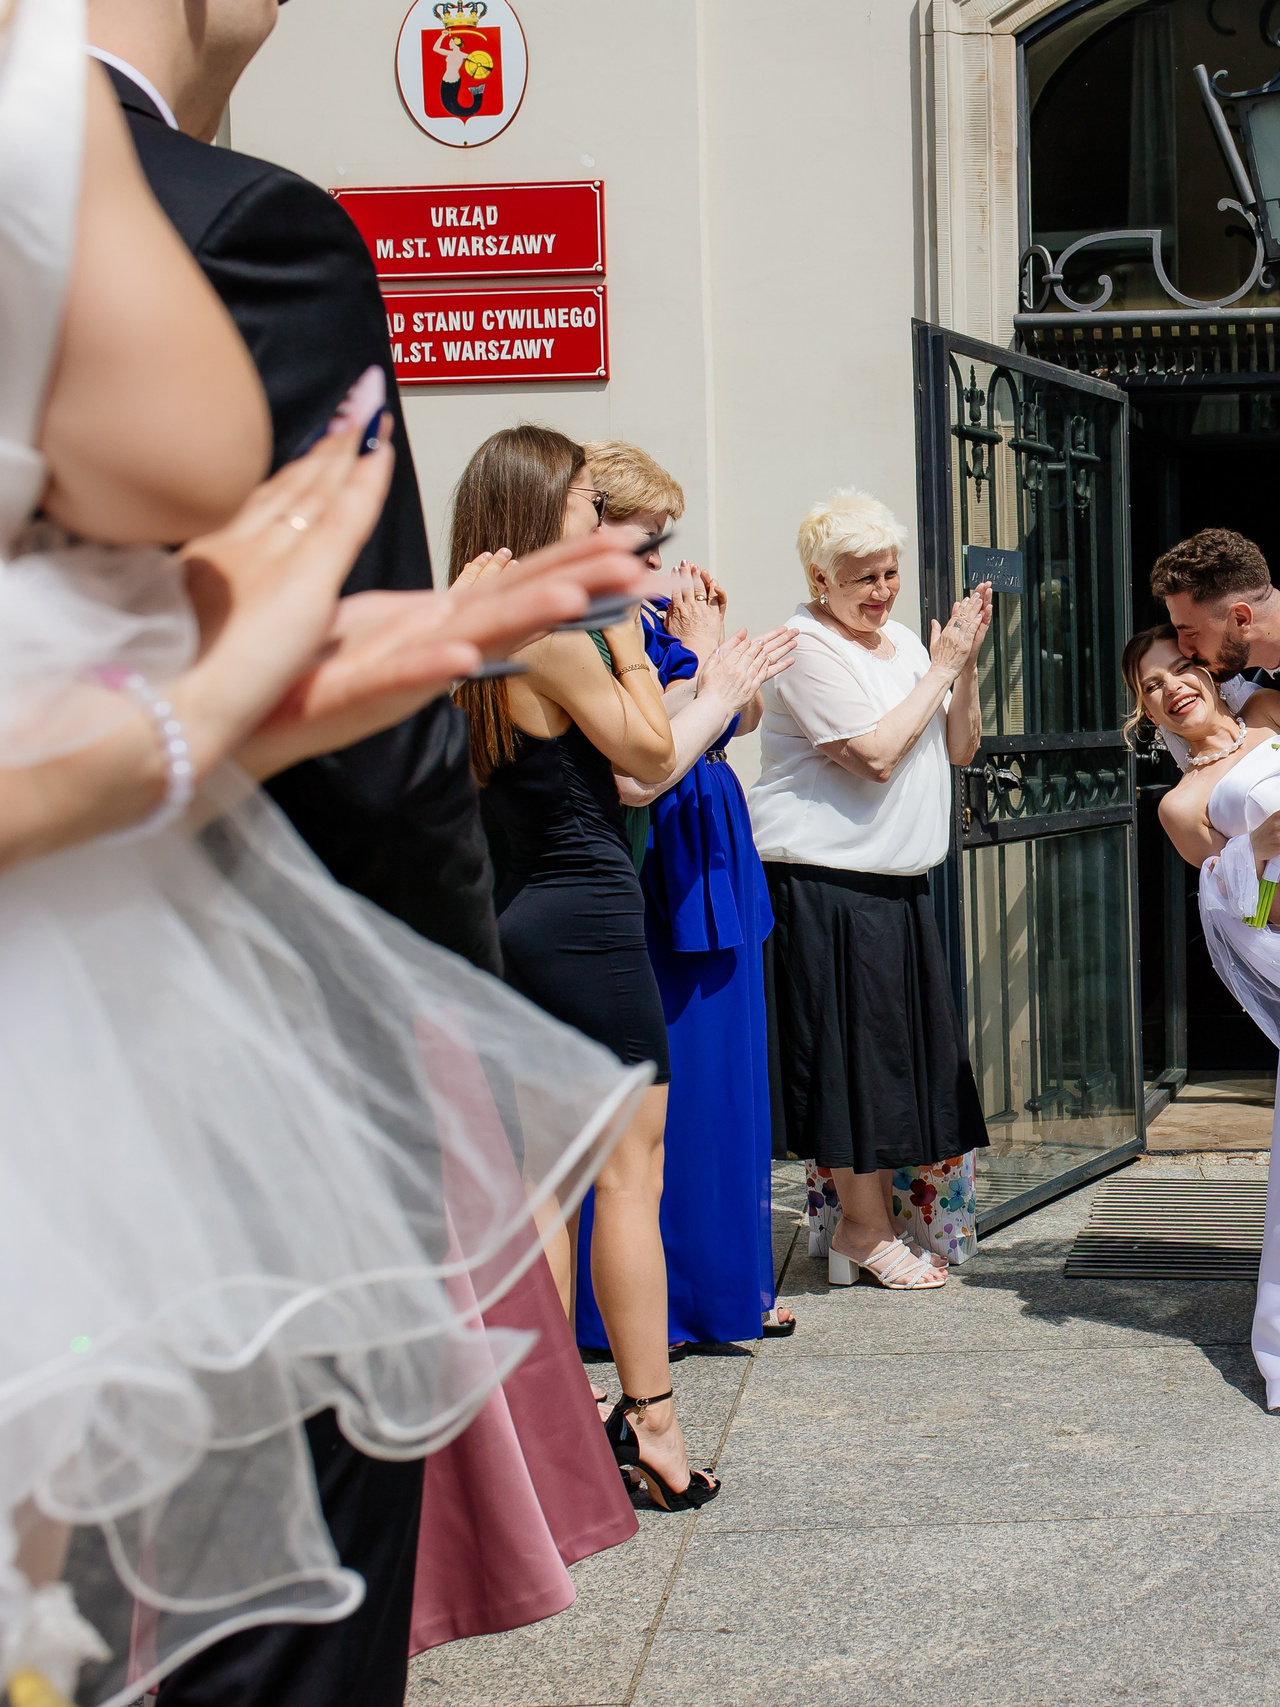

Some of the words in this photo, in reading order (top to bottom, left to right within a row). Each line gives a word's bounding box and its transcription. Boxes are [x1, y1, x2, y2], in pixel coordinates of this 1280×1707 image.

[430, 205, 499, 230] URZĄD
[376, 238, 431, 259] M.ST.
[437, 233, 557, 257] WARSZAWY
[412, 310, 475, 332] STANU
[482, 306, 597, 330] CYWILNEGO
[443, 338, 555, 361] WARSZAWY
